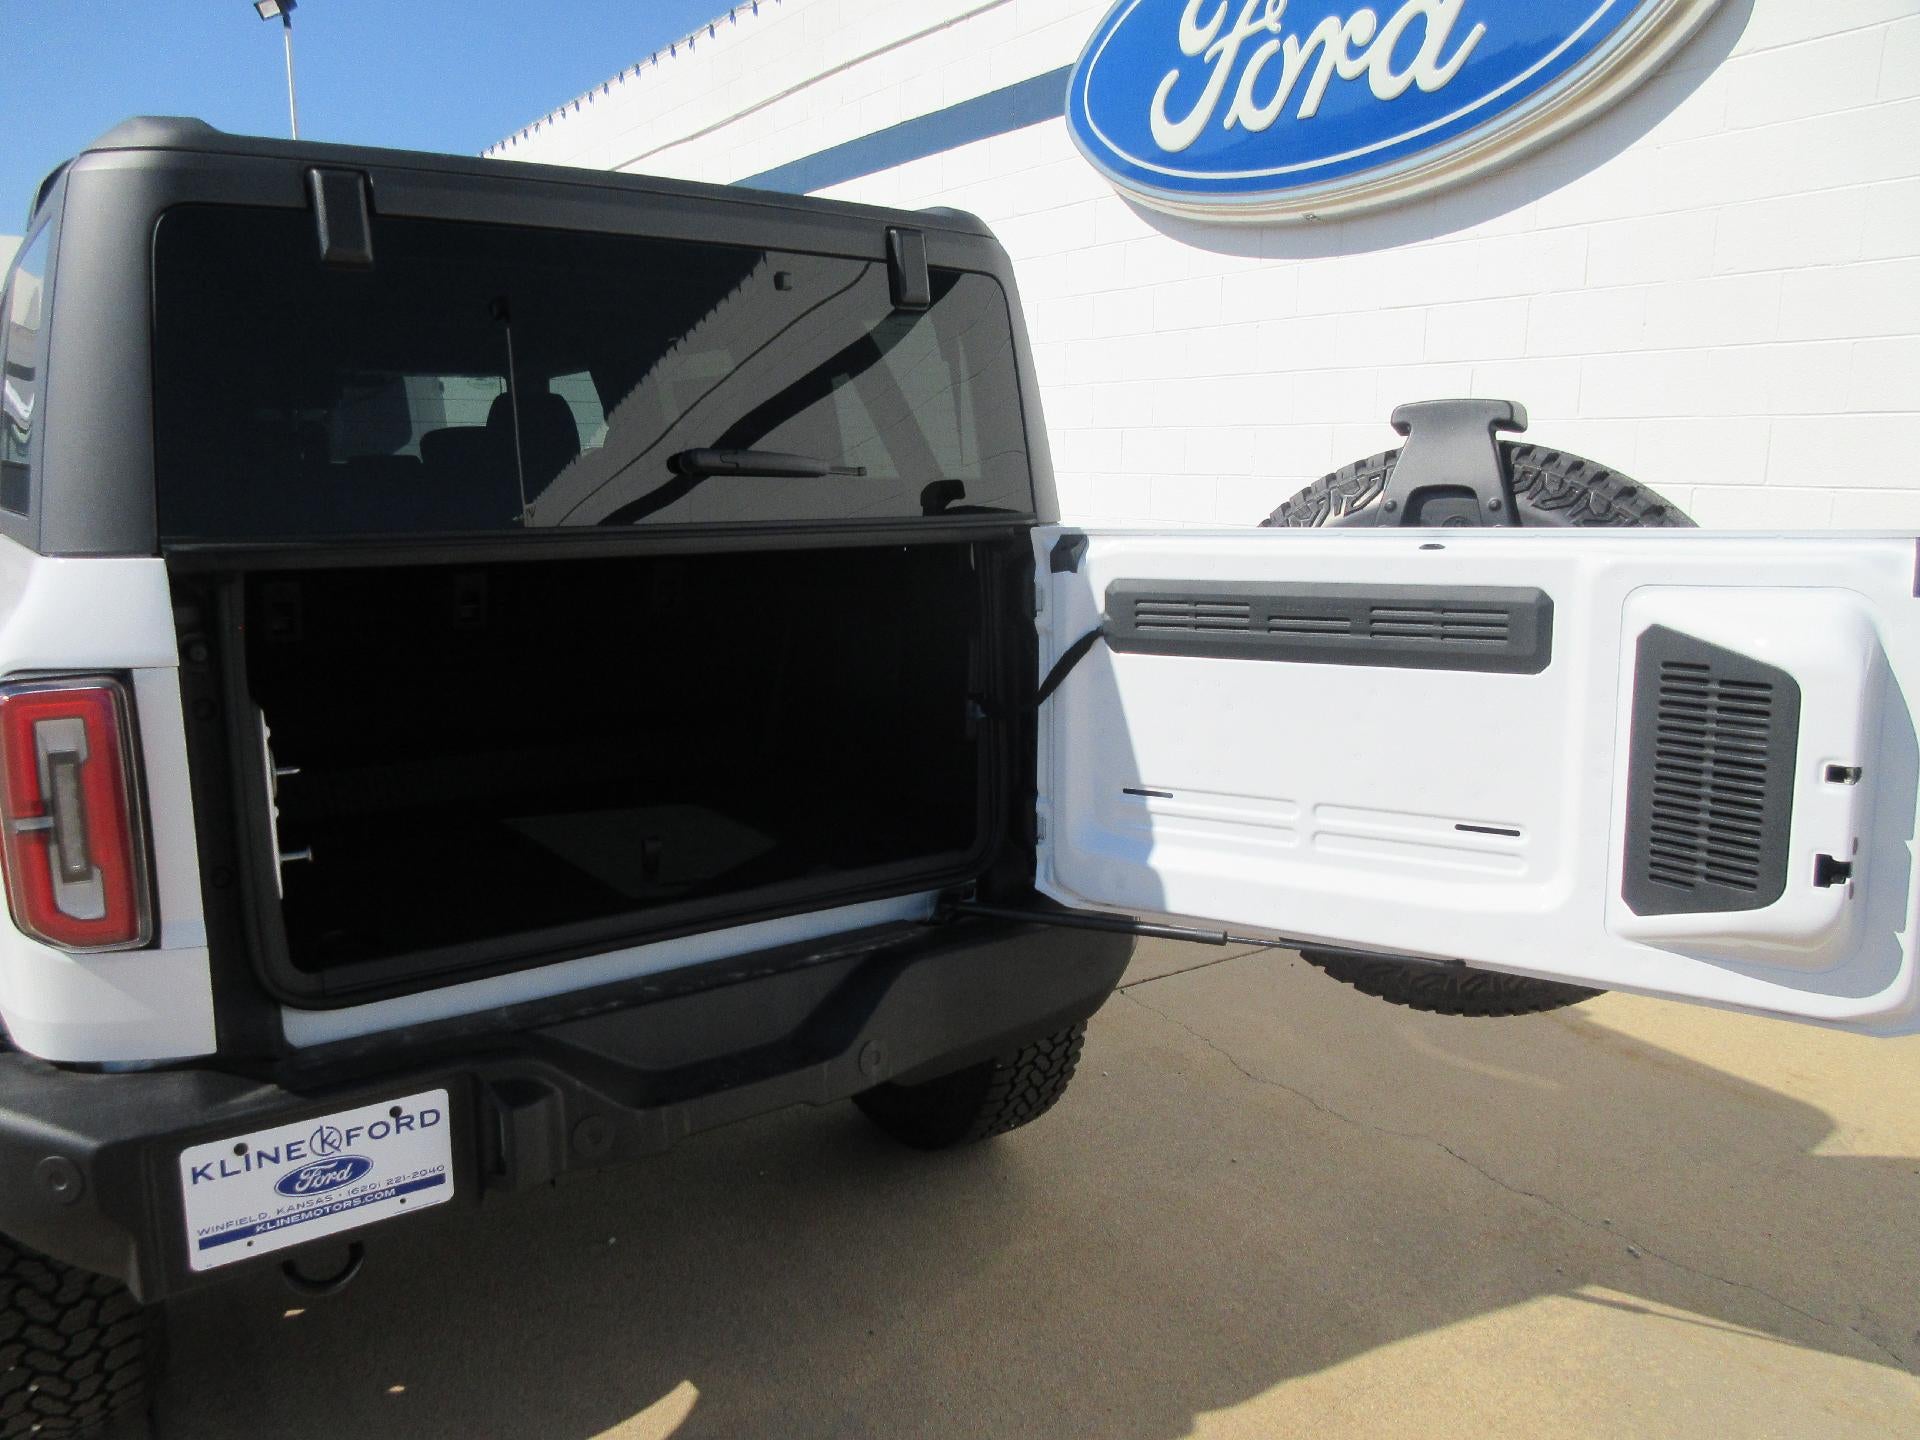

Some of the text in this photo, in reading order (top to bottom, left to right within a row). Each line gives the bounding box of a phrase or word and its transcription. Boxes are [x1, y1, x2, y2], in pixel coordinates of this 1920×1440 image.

[1149, 0, 1487, 154] Ford
[191, 1139, 306, 1185] KLINE
[346, 1108, 441, 1147] FORD
[294, 1160, 353, 1193] Ford
[197, 1211, 271, 1236] WINFIELD,
[276, 1194, 334, 1217] KANSAS
[386, 1164, 446, 1186] 221-2040
[255, 1188, 397, 1233] KLINEMOTORS.COM
